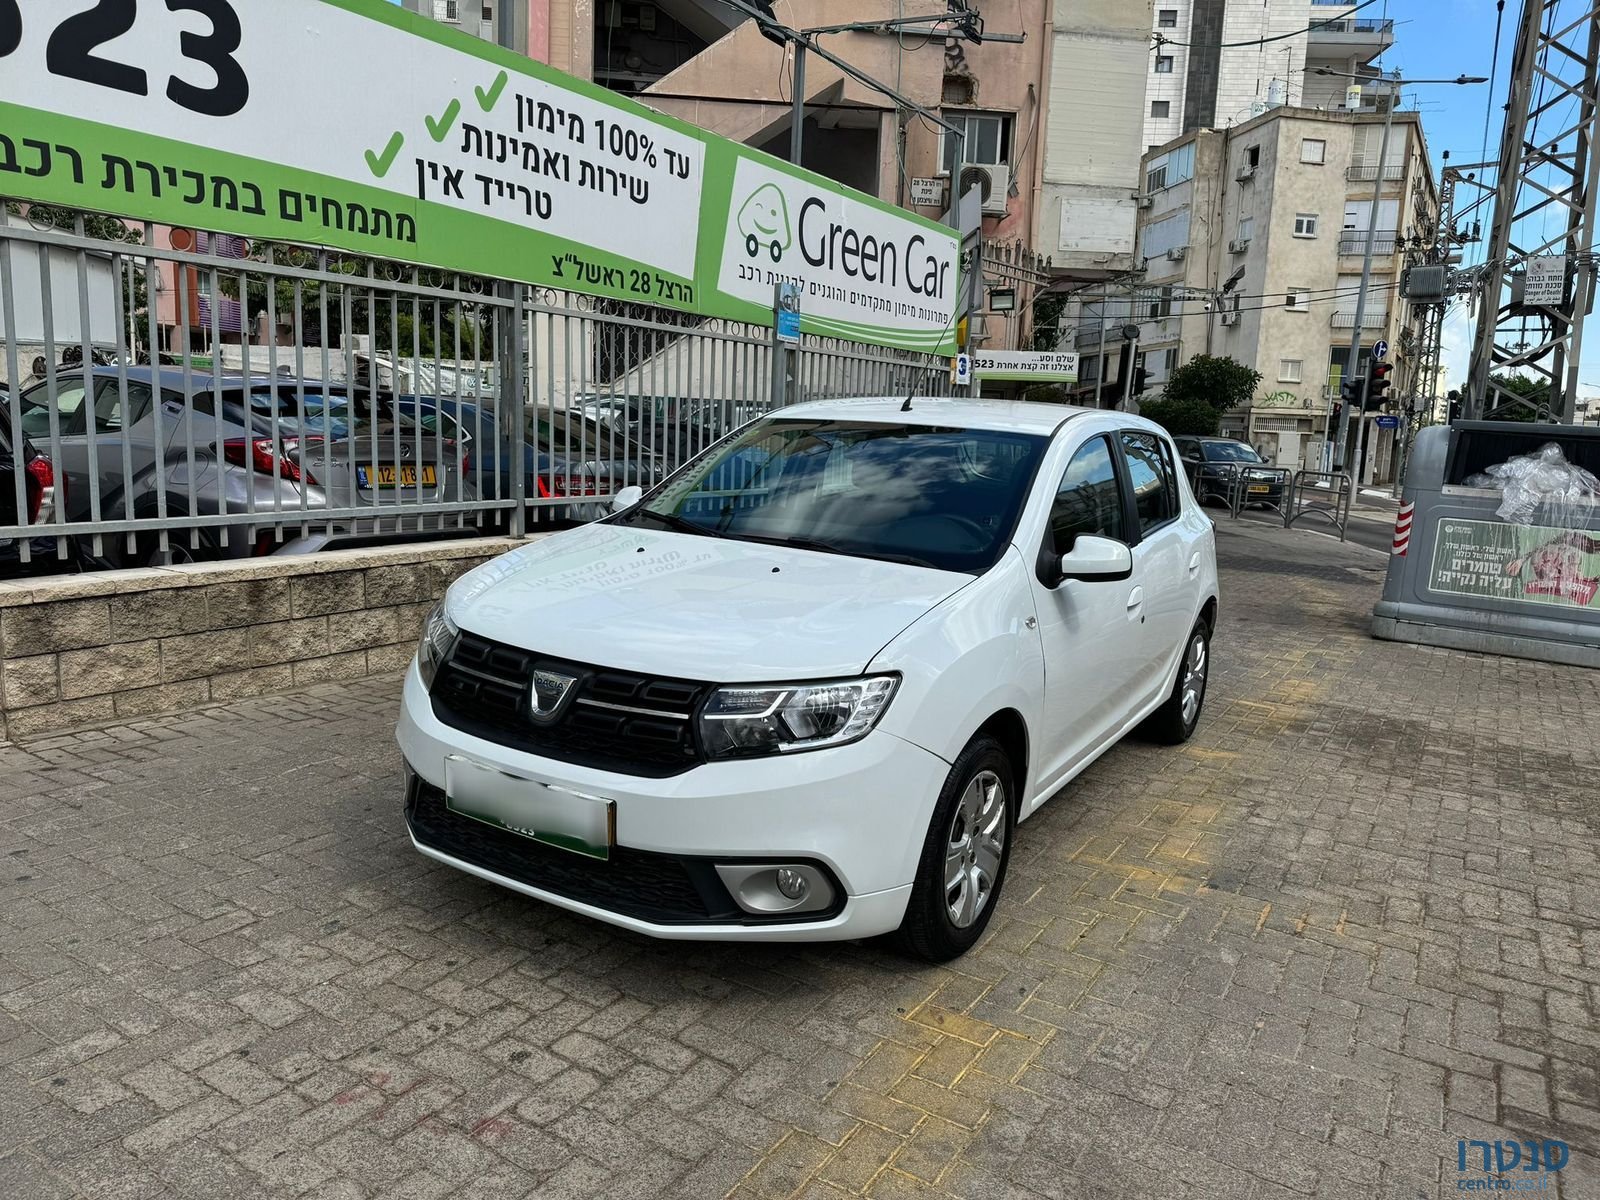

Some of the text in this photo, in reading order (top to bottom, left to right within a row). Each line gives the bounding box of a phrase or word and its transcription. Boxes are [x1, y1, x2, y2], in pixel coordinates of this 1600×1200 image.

[0, 0, 248, 116] 23
[515, 93, 690, 180] עד 100% מימון
[461, 122, 649, 205] שירות ואמינות
[101, 153, 267, 217] במכירת
[415, 157, 552, 220] טרייד אין
[279, 189, 417, 244] מתמחים
[798, 196, 950, 300] Green Car
[629, 268, 650, 295] 28
[738, 263, 762, 284] רכב
[656, 275, 693, 304] הרצל
[809, 282, 846, 303] והוגנים
[850, 292, 892, 313] מתקדמים
[894, 302, 916, 318] מימון
[918, 307, 949, 325] פתרונות
[1020, 363, 1038, 372] קצת
[1051, 363, 1074, 371] אצלנו
[1056, 354, 1075, 363] שלם
[1452, 558, 1502, 575] שומרים
[1438, 570, 1476, 586] נקייה!
[1479, 574, 1513, 589] עליה
[536, 677, 564, 690] DACIA
